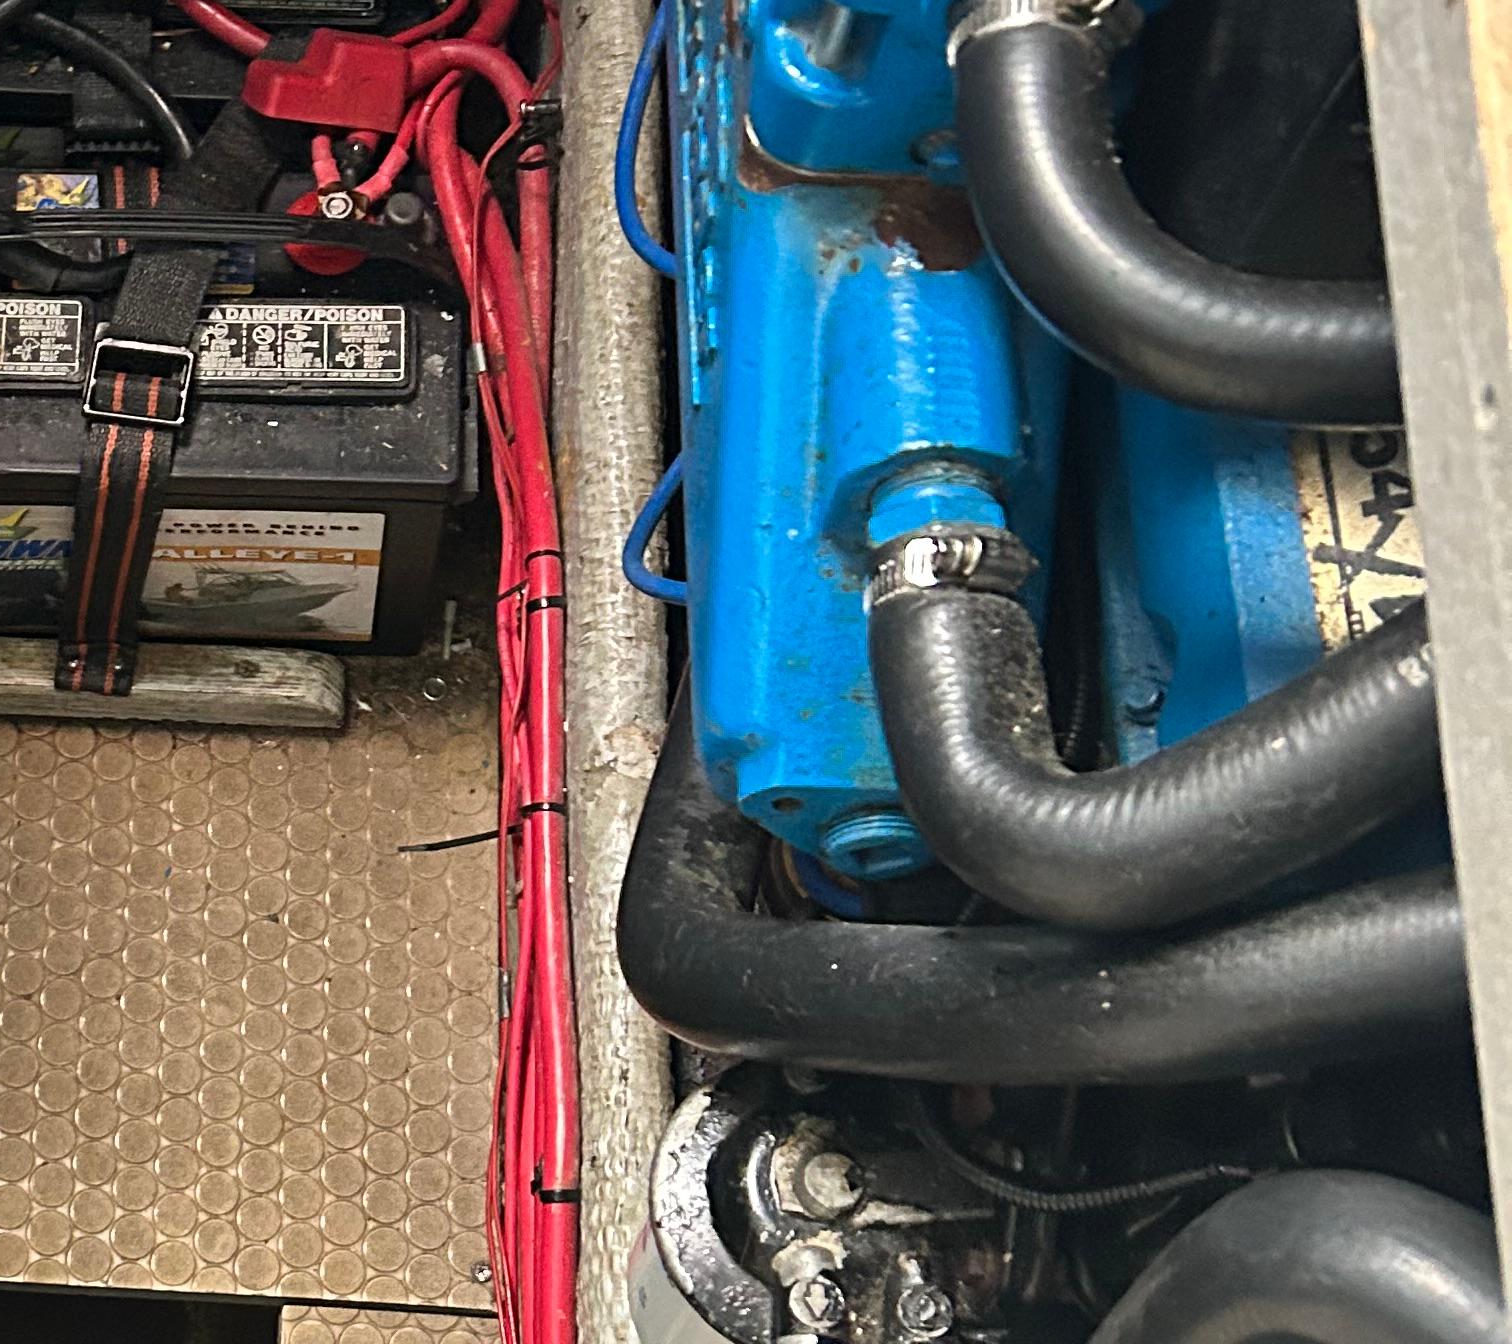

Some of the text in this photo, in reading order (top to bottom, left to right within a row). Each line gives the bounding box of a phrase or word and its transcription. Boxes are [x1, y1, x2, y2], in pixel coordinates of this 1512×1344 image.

[225, 308, 384, 322] DANGER/POISON
[158, 528, 326, 536] ERFORMANCE
[151, 548, 356, 562] ALLEYE-1
